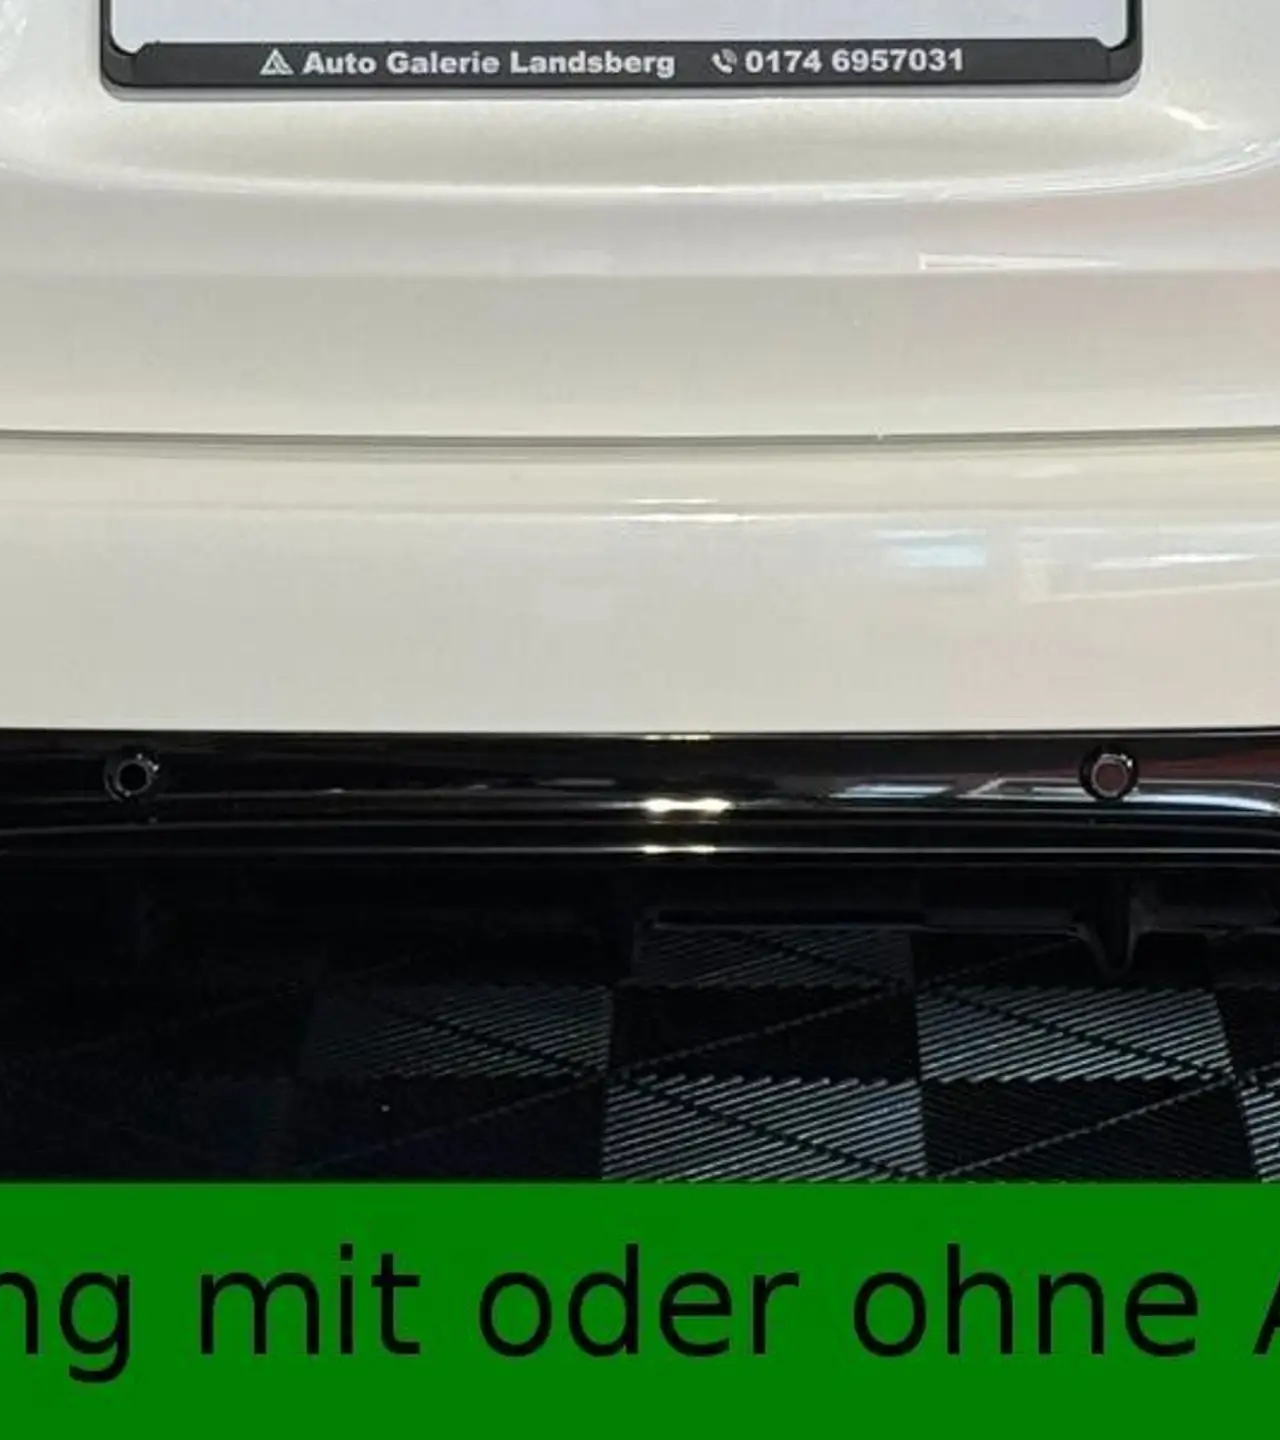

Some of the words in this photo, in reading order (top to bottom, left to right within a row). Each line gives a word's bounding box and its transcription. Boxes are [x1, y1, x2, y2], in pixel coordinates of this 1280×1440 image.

[302, 51, 376, 74] Auto
[387, 51, 499, 75] Galerie
[511, 50, 675, 79] Landsberg
[745, 49, 822, 73] 0174
[832, 48, 963, 72] 6957031
